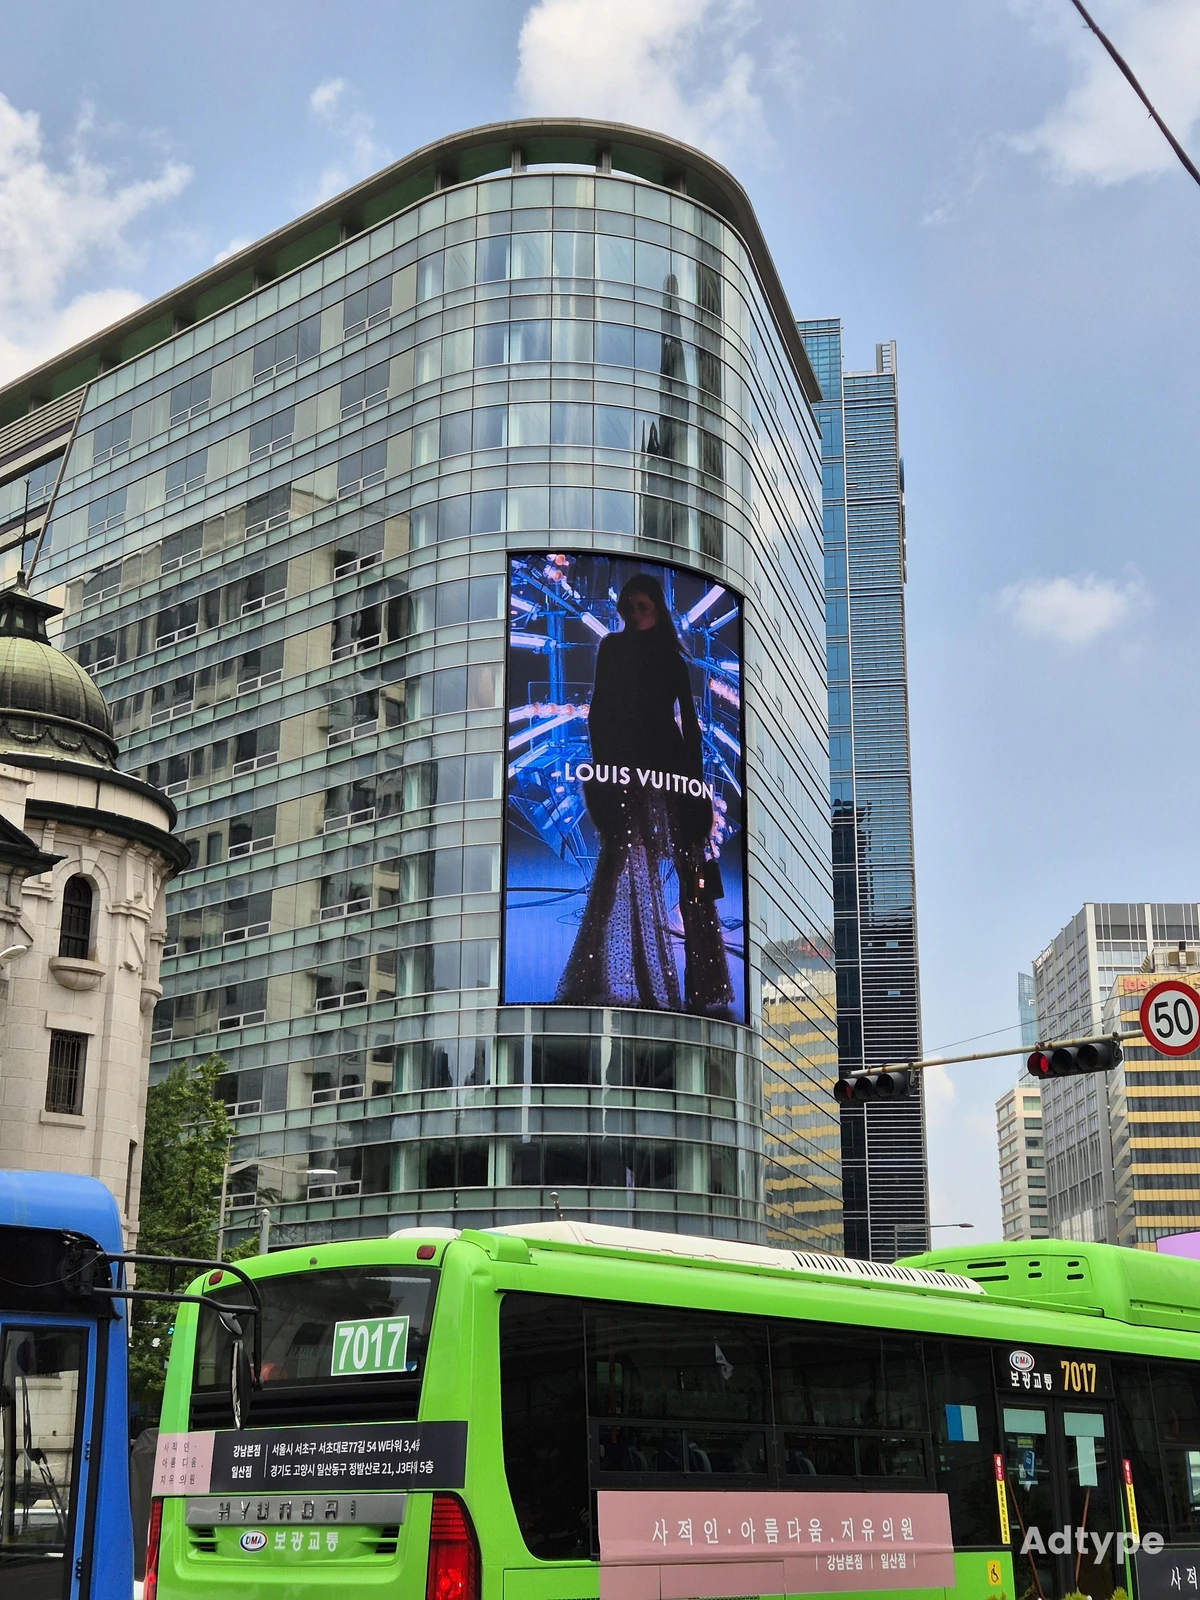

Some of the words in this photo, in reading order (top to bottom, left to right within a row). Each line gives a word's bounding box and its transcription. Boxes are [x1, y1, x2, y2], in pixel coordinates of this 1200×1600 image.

[565, 762, 631, 785] LOUIS
[636, 768, 714, 801] VUITTON
[1154, 998, 1193, 1038] 50
[338, 1322, 405, 1370] 7017
[1010, 1370, 1053, 1391] 보광교통
[1060, 1360, 1097, 1393] 7017
[233, 1443, 261, 1458] 강남본점
[272, 1442, 294, 1456] 서울시
[295, 1442, 317, 1455] 서초구
[366, 1440, 377, 1453] 54
[231, 1465, 252, 1479] 일산점
[270, 1464, 292, 1477] 경기도
[293, 1463, 315, 1477] 고양시
[317, 1462, 347, 1476] 일산동구
[419, 1459, 434, 1474] 5층
[218, 1500, 357, 1521] HYUNDAI
[274, 1531, 339, 1552] 보광교통
[827, 1553, 863, 1571] 강남본점
[881, 1552, 906, 1569] 일산점
